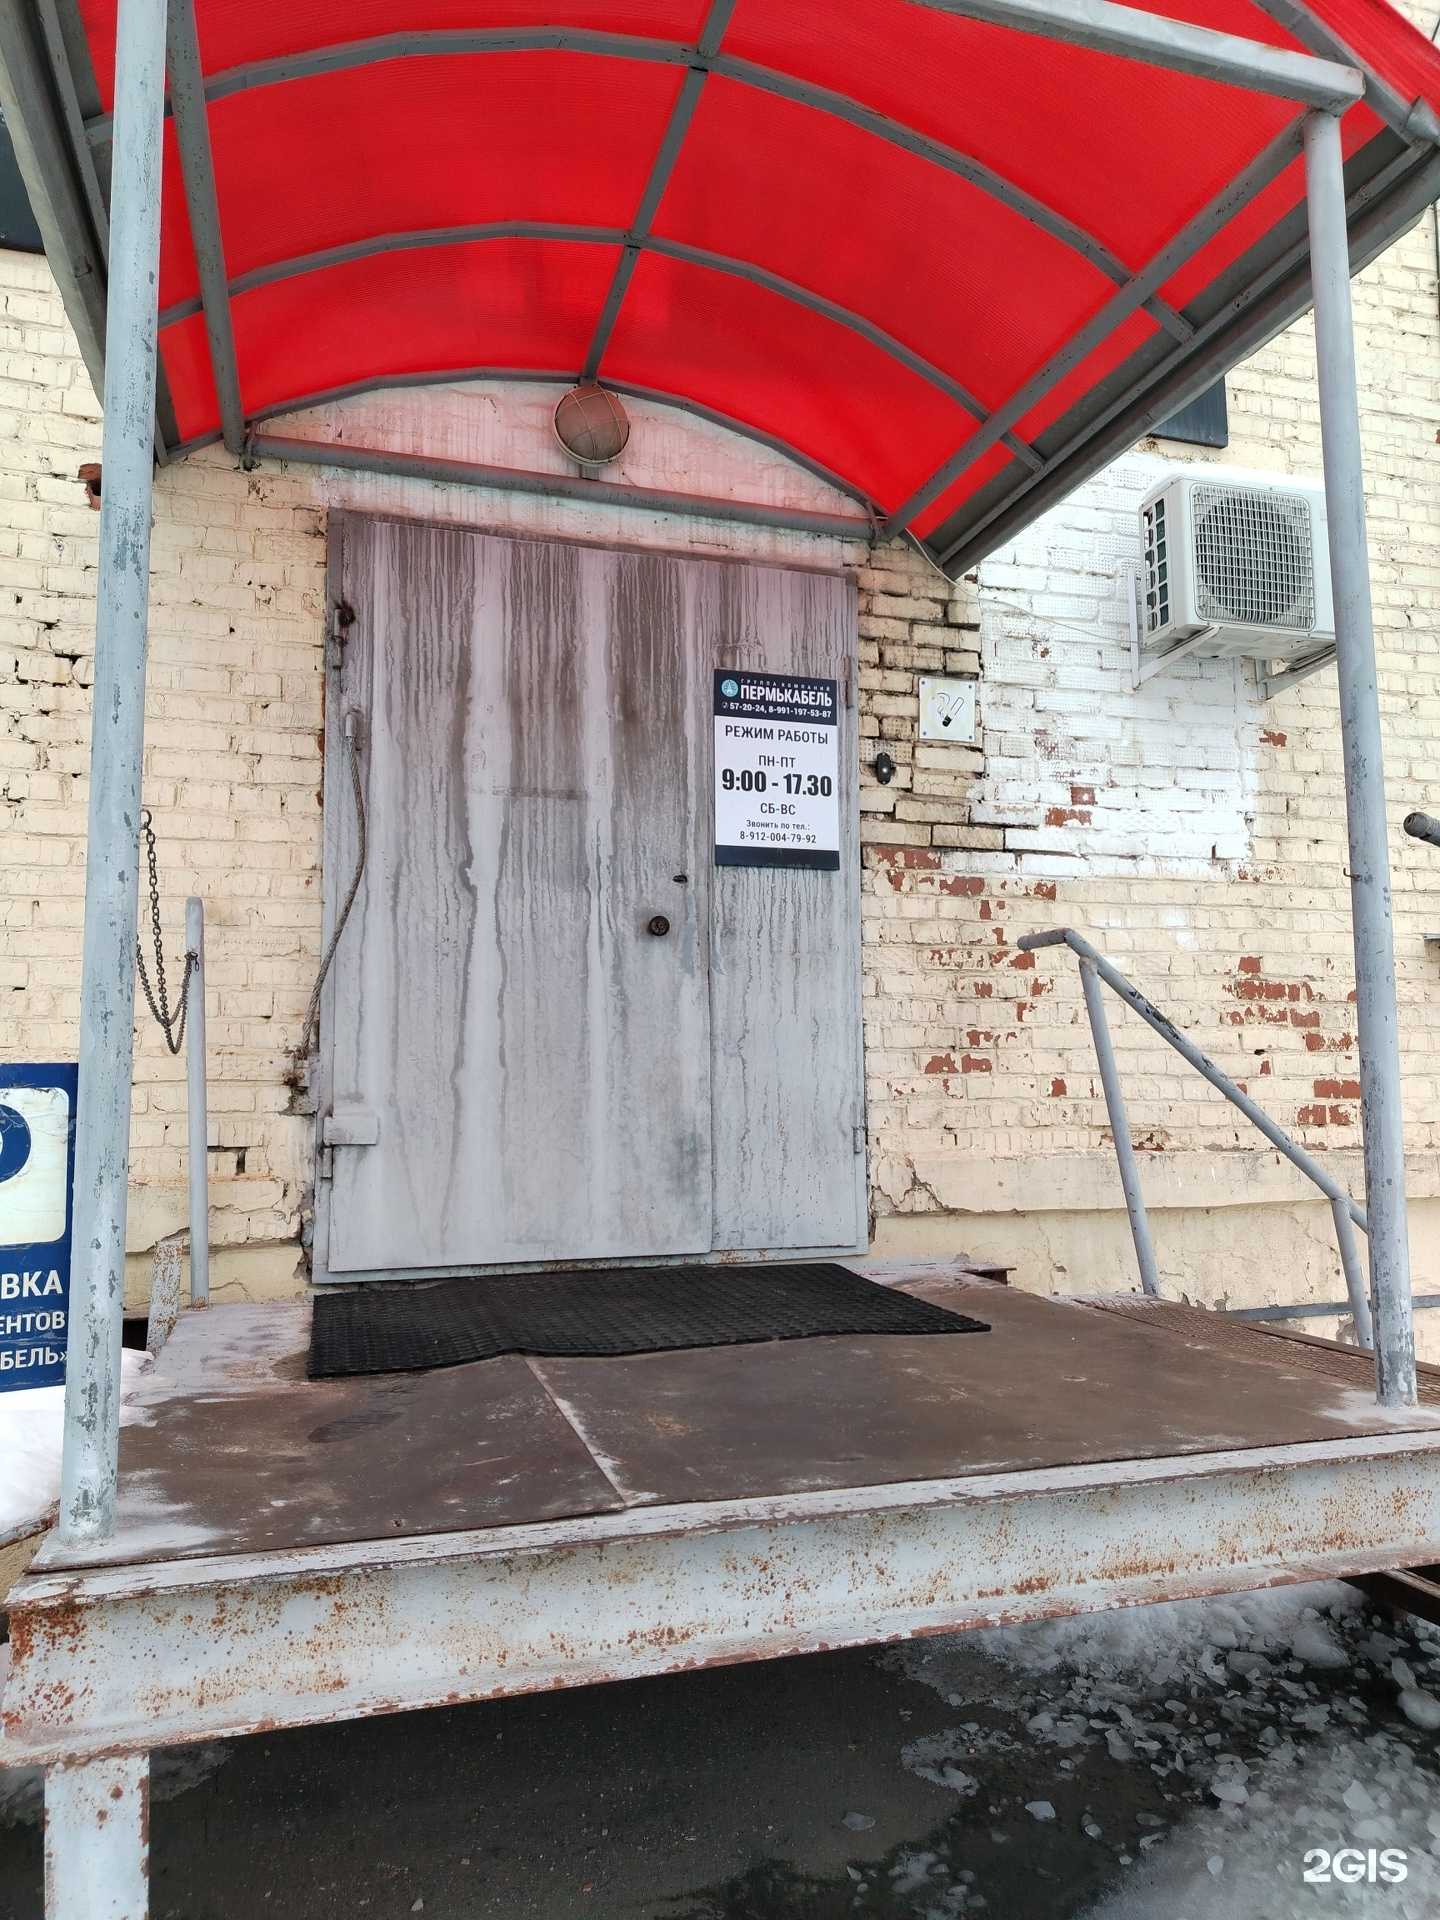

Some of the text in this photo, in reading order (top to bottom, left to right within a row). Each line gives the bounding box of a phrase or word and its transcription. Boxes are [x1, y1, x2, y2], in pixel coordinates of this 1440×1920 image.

[740, 684, 833, 707] ПЕРМЬКАБЕЛЬ
[729, 702, 767, 713] 57-20-24,
[725, 725, 828, 744] РЕЖИМ РАБОТЫ
[758, 755, 796, 768] ПН-ПТ
[721, 768, 767, 793] 9:00
[783, 773, 832, 797] 17.30
[760, 802, 796, 815] СБ-ВС
[746, 819, 779, 829] Звонить
[780, 822, 790, 830] по
[739, 830, 817, 844] 8-912-004-79-92
